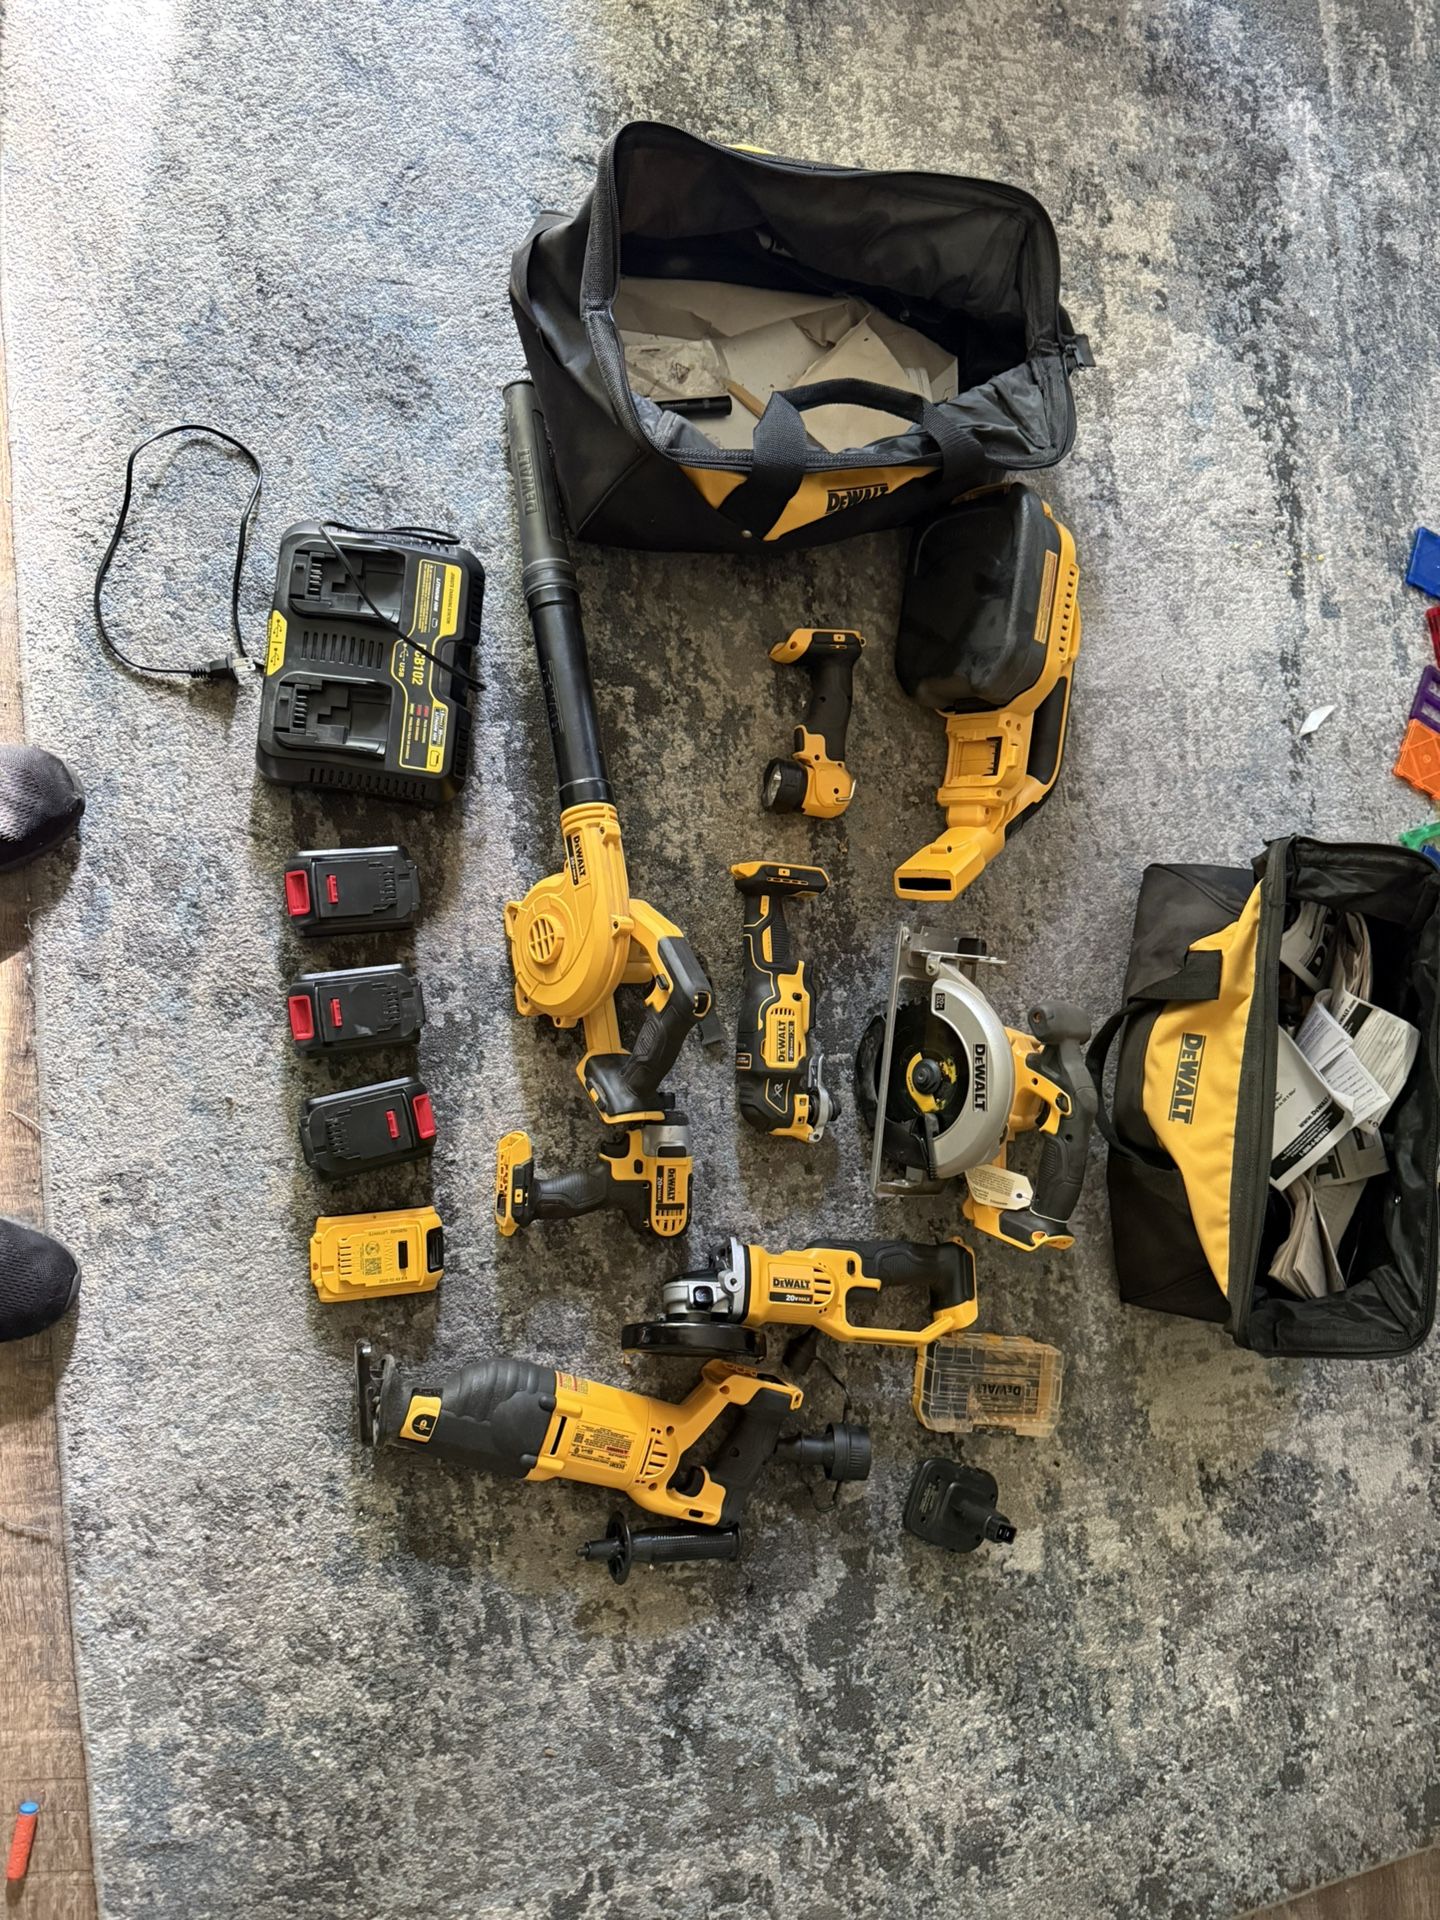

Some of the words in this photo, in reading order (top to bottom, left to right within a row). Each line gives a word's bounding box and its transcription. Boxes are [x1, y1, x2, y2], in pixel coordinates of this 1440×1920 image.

[573, 835, 586, 877] DEWALT
[777, 1020, 787, 1062] DEWALT
[974, 1043, 986, 1112] DEWALT
[1171, 1032, 1205, 1124] DEWALT
[667, 1167, 676, 1201] DEWALT
[772, 1277, 811, 1290] DEWALT
